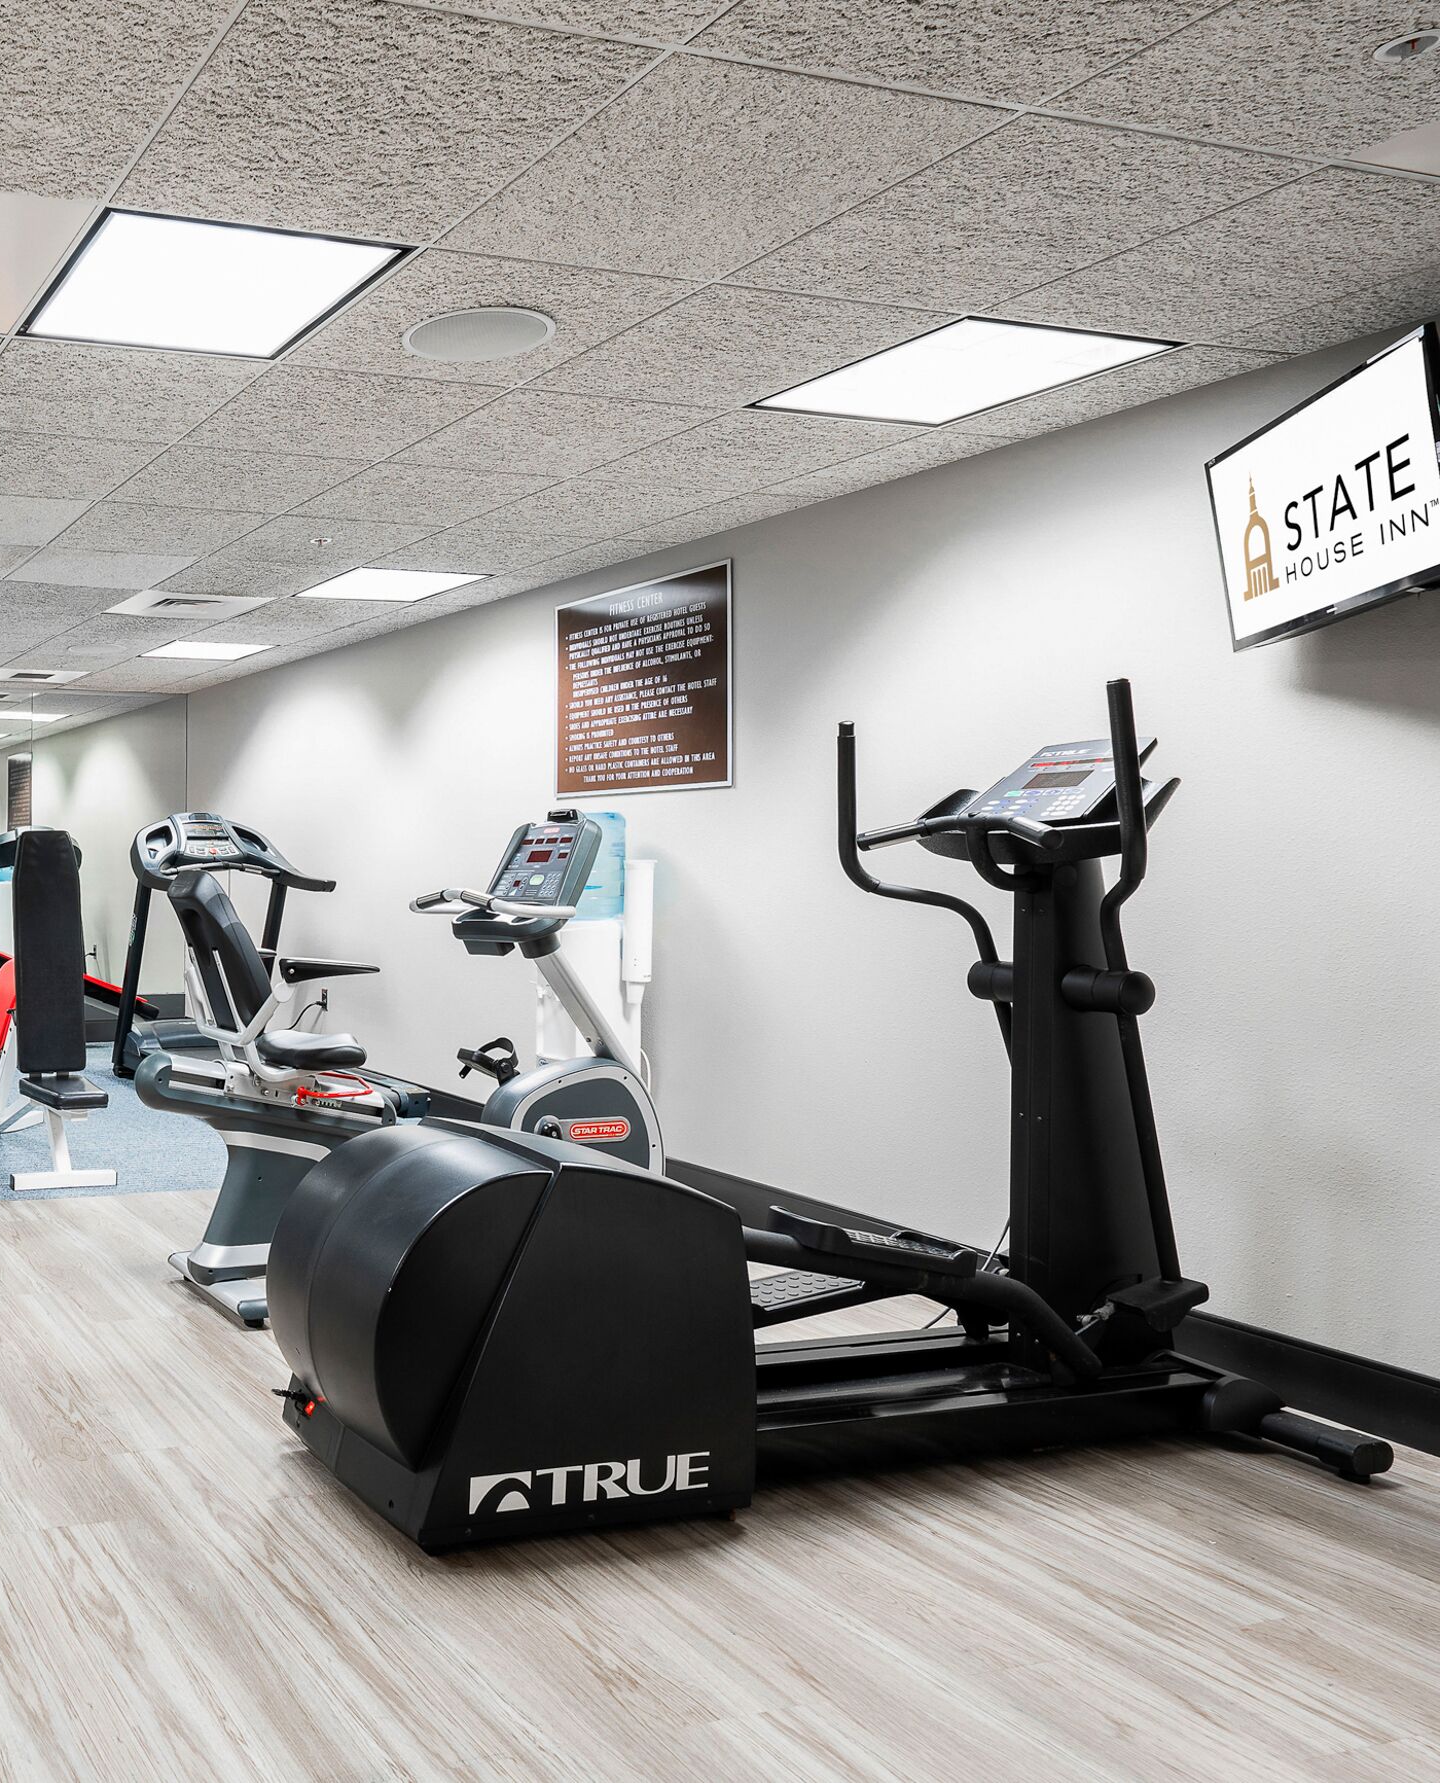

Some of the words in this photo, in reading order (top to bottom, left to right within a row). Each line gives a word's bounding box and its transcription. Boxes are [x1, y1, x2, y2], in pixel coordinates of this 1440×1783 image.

[1284, 433, 1416, 552] STATE
[1285, 532, 1365, 584] HOUSE
[609, 599, 634, 616] FITNESS
[637, 592, 664, 609] CENTER
[640, 616, 646, 624] OF
[674, 606, 688, 617] HOTEL
[689, 602, 706, 613] GUESTS
[634, 638, 637, 646] A
[687, 626, 694, 635] TO
[695, 624, 703, 634] DO
[704, 623, 711, 632] SO
[636, 648, 644, 657] NOT
[646, 646, 654, 655] USE
[655, 644, 664, 653] THE
[635, 661, 641, 669] OF
[694, 649, 701, 658] OR
[644, 677, 654, 686] AGE
[654, 676, 661, 684] OF
[677, 683, 686, 692] THE
[687, 680, 702, 690] HOTEL
[703, 678, 717, 688] STAFF
[663, 697, 669, 706] OF
[671, 694, 688, 705] OTHERS
[658, 710, 668, 719] ARE
[650, 734, 656, 743] TO
[633, 748, 640, 756] TO
[640, 747, 649, 755] THE
[650, 757, 660, 766] ARE
[684, 754, 690, 763] IN
[691, 753, 701, 762] THIS
[702, 752, 716, 761] AREA
[651, 769, 660, 777] AND
[574, 1127, 597, 1135] STAR
[536, 1451, 710, 1506] TRUE
